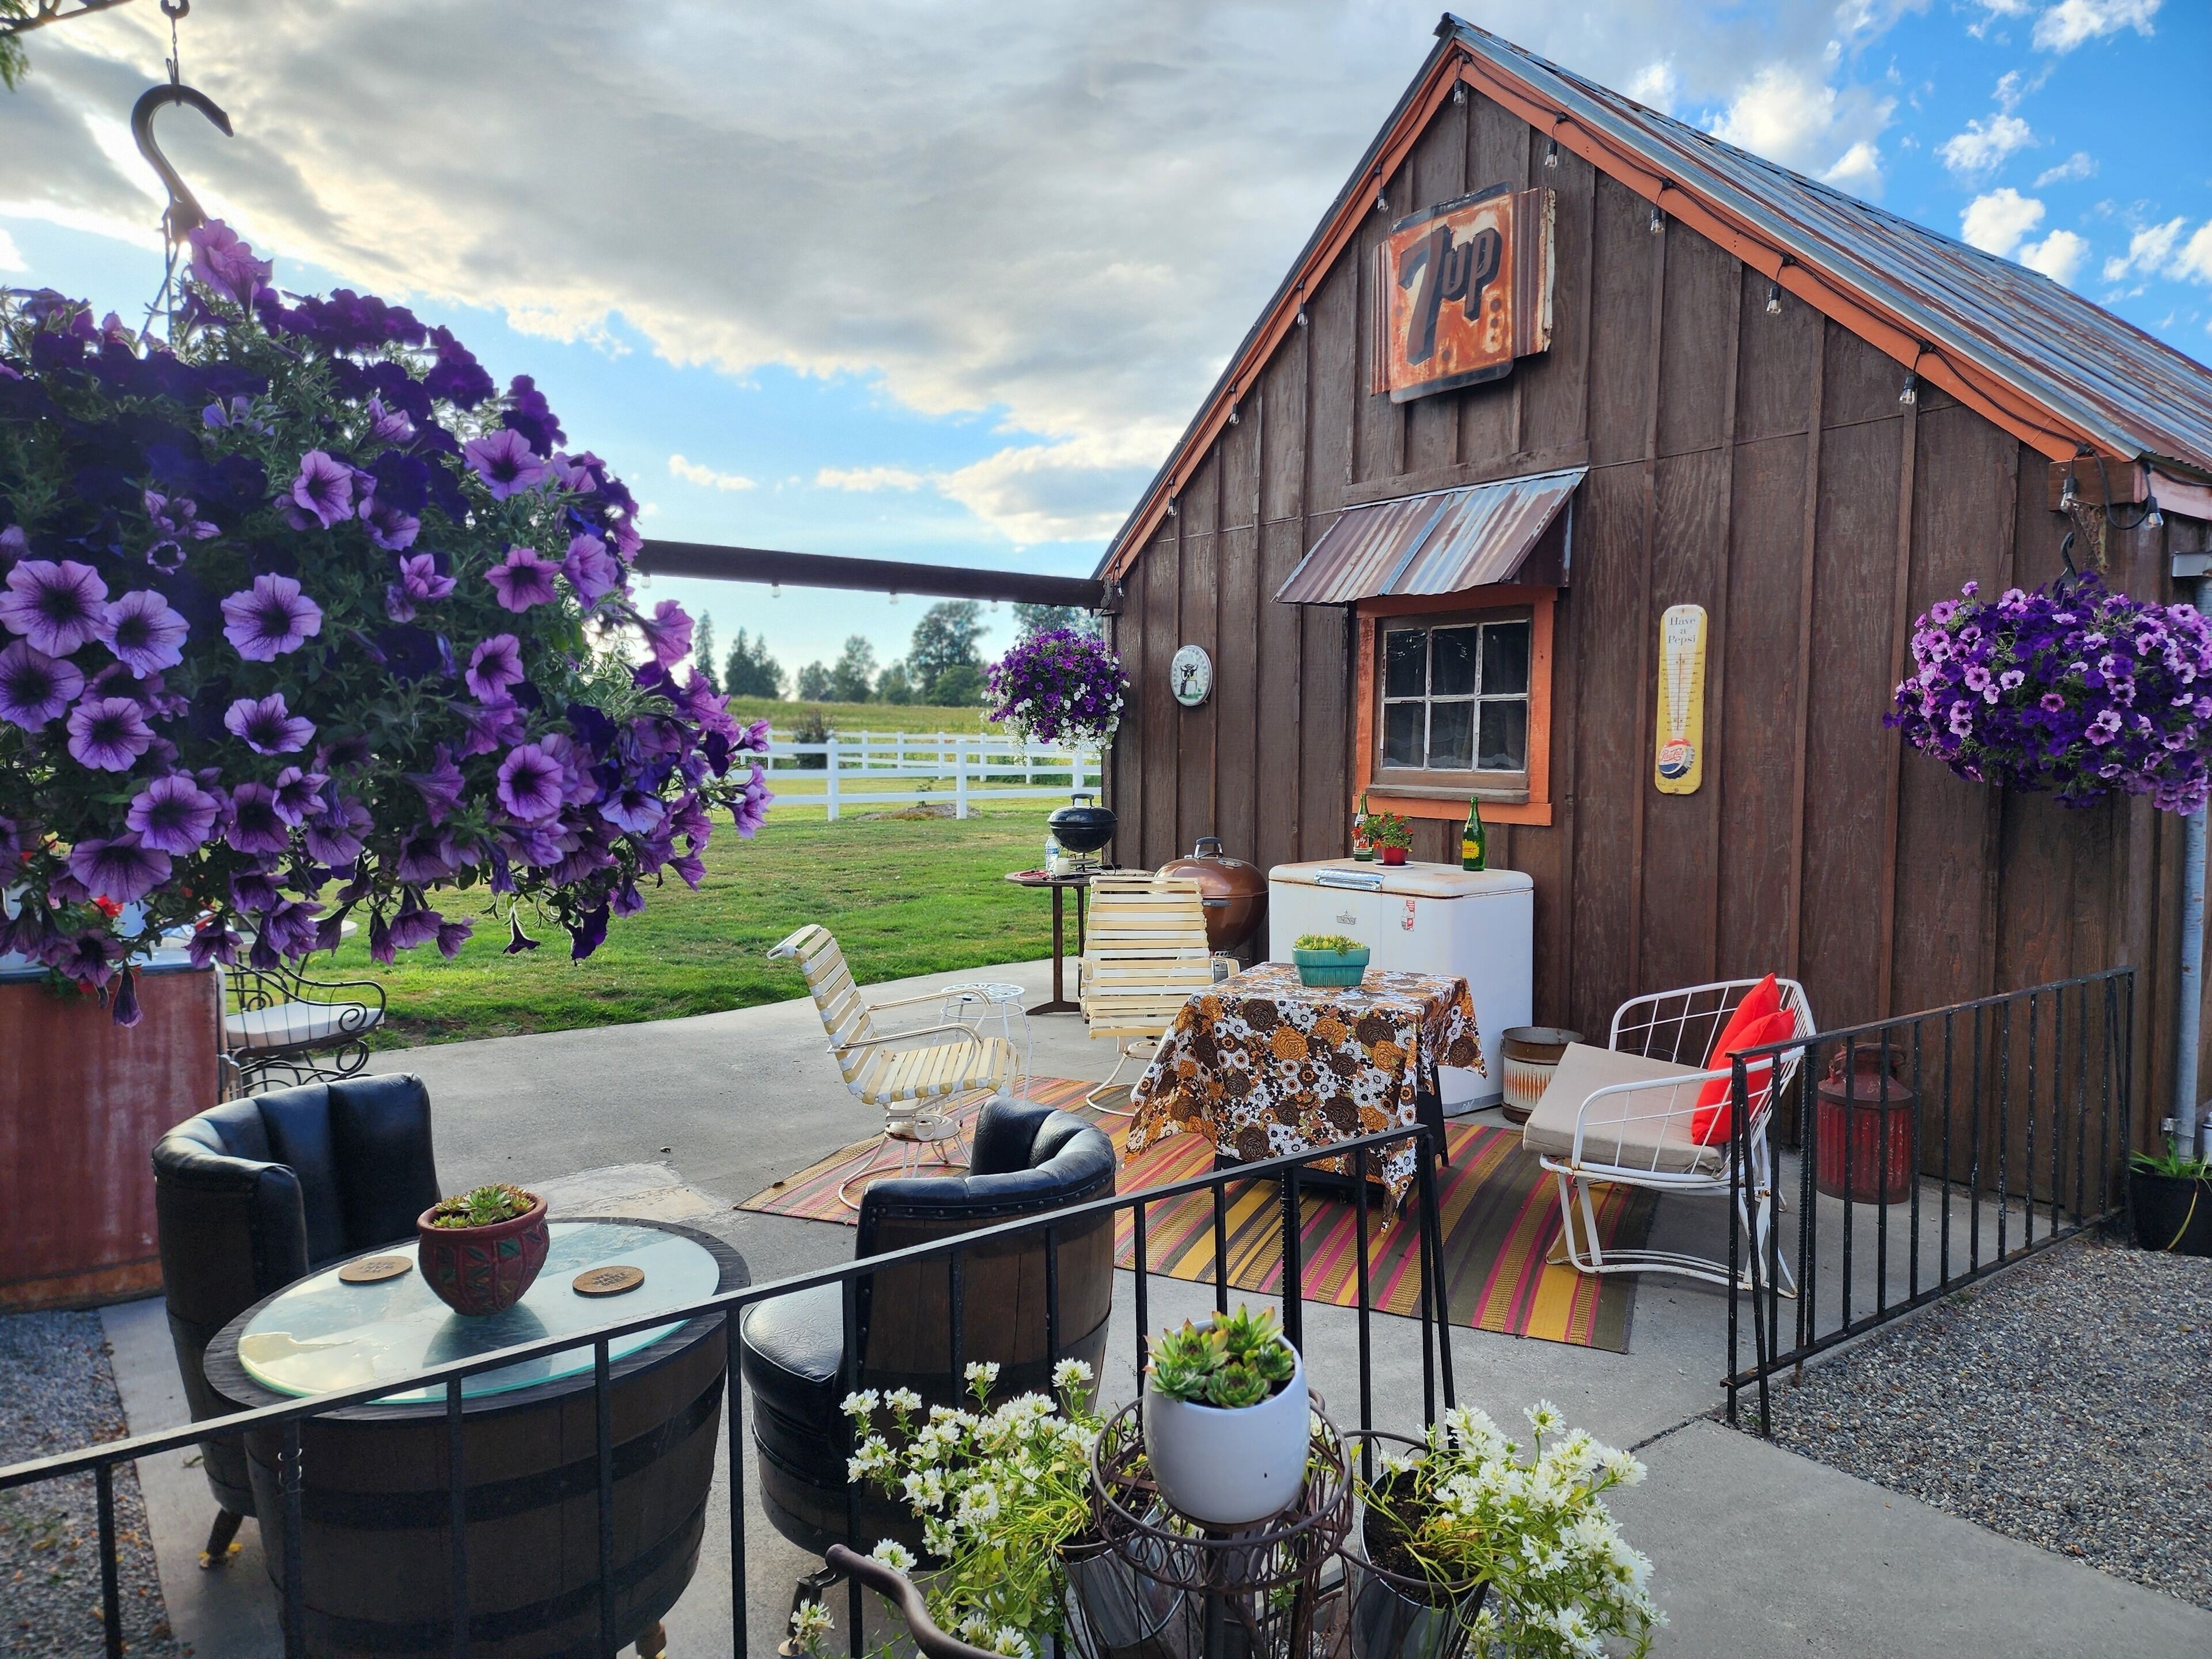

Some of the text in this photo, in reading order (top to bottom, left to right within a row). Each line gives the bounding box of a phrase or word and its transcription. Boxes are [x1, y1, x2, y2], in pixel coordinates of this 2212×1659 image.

[1671, 617, 1696, 625] Have
[1668, 635, 1696, 646] Pepsi
[592, 1272, 610, 1280] WE
[592, 1272, 626, 1285] WANT
